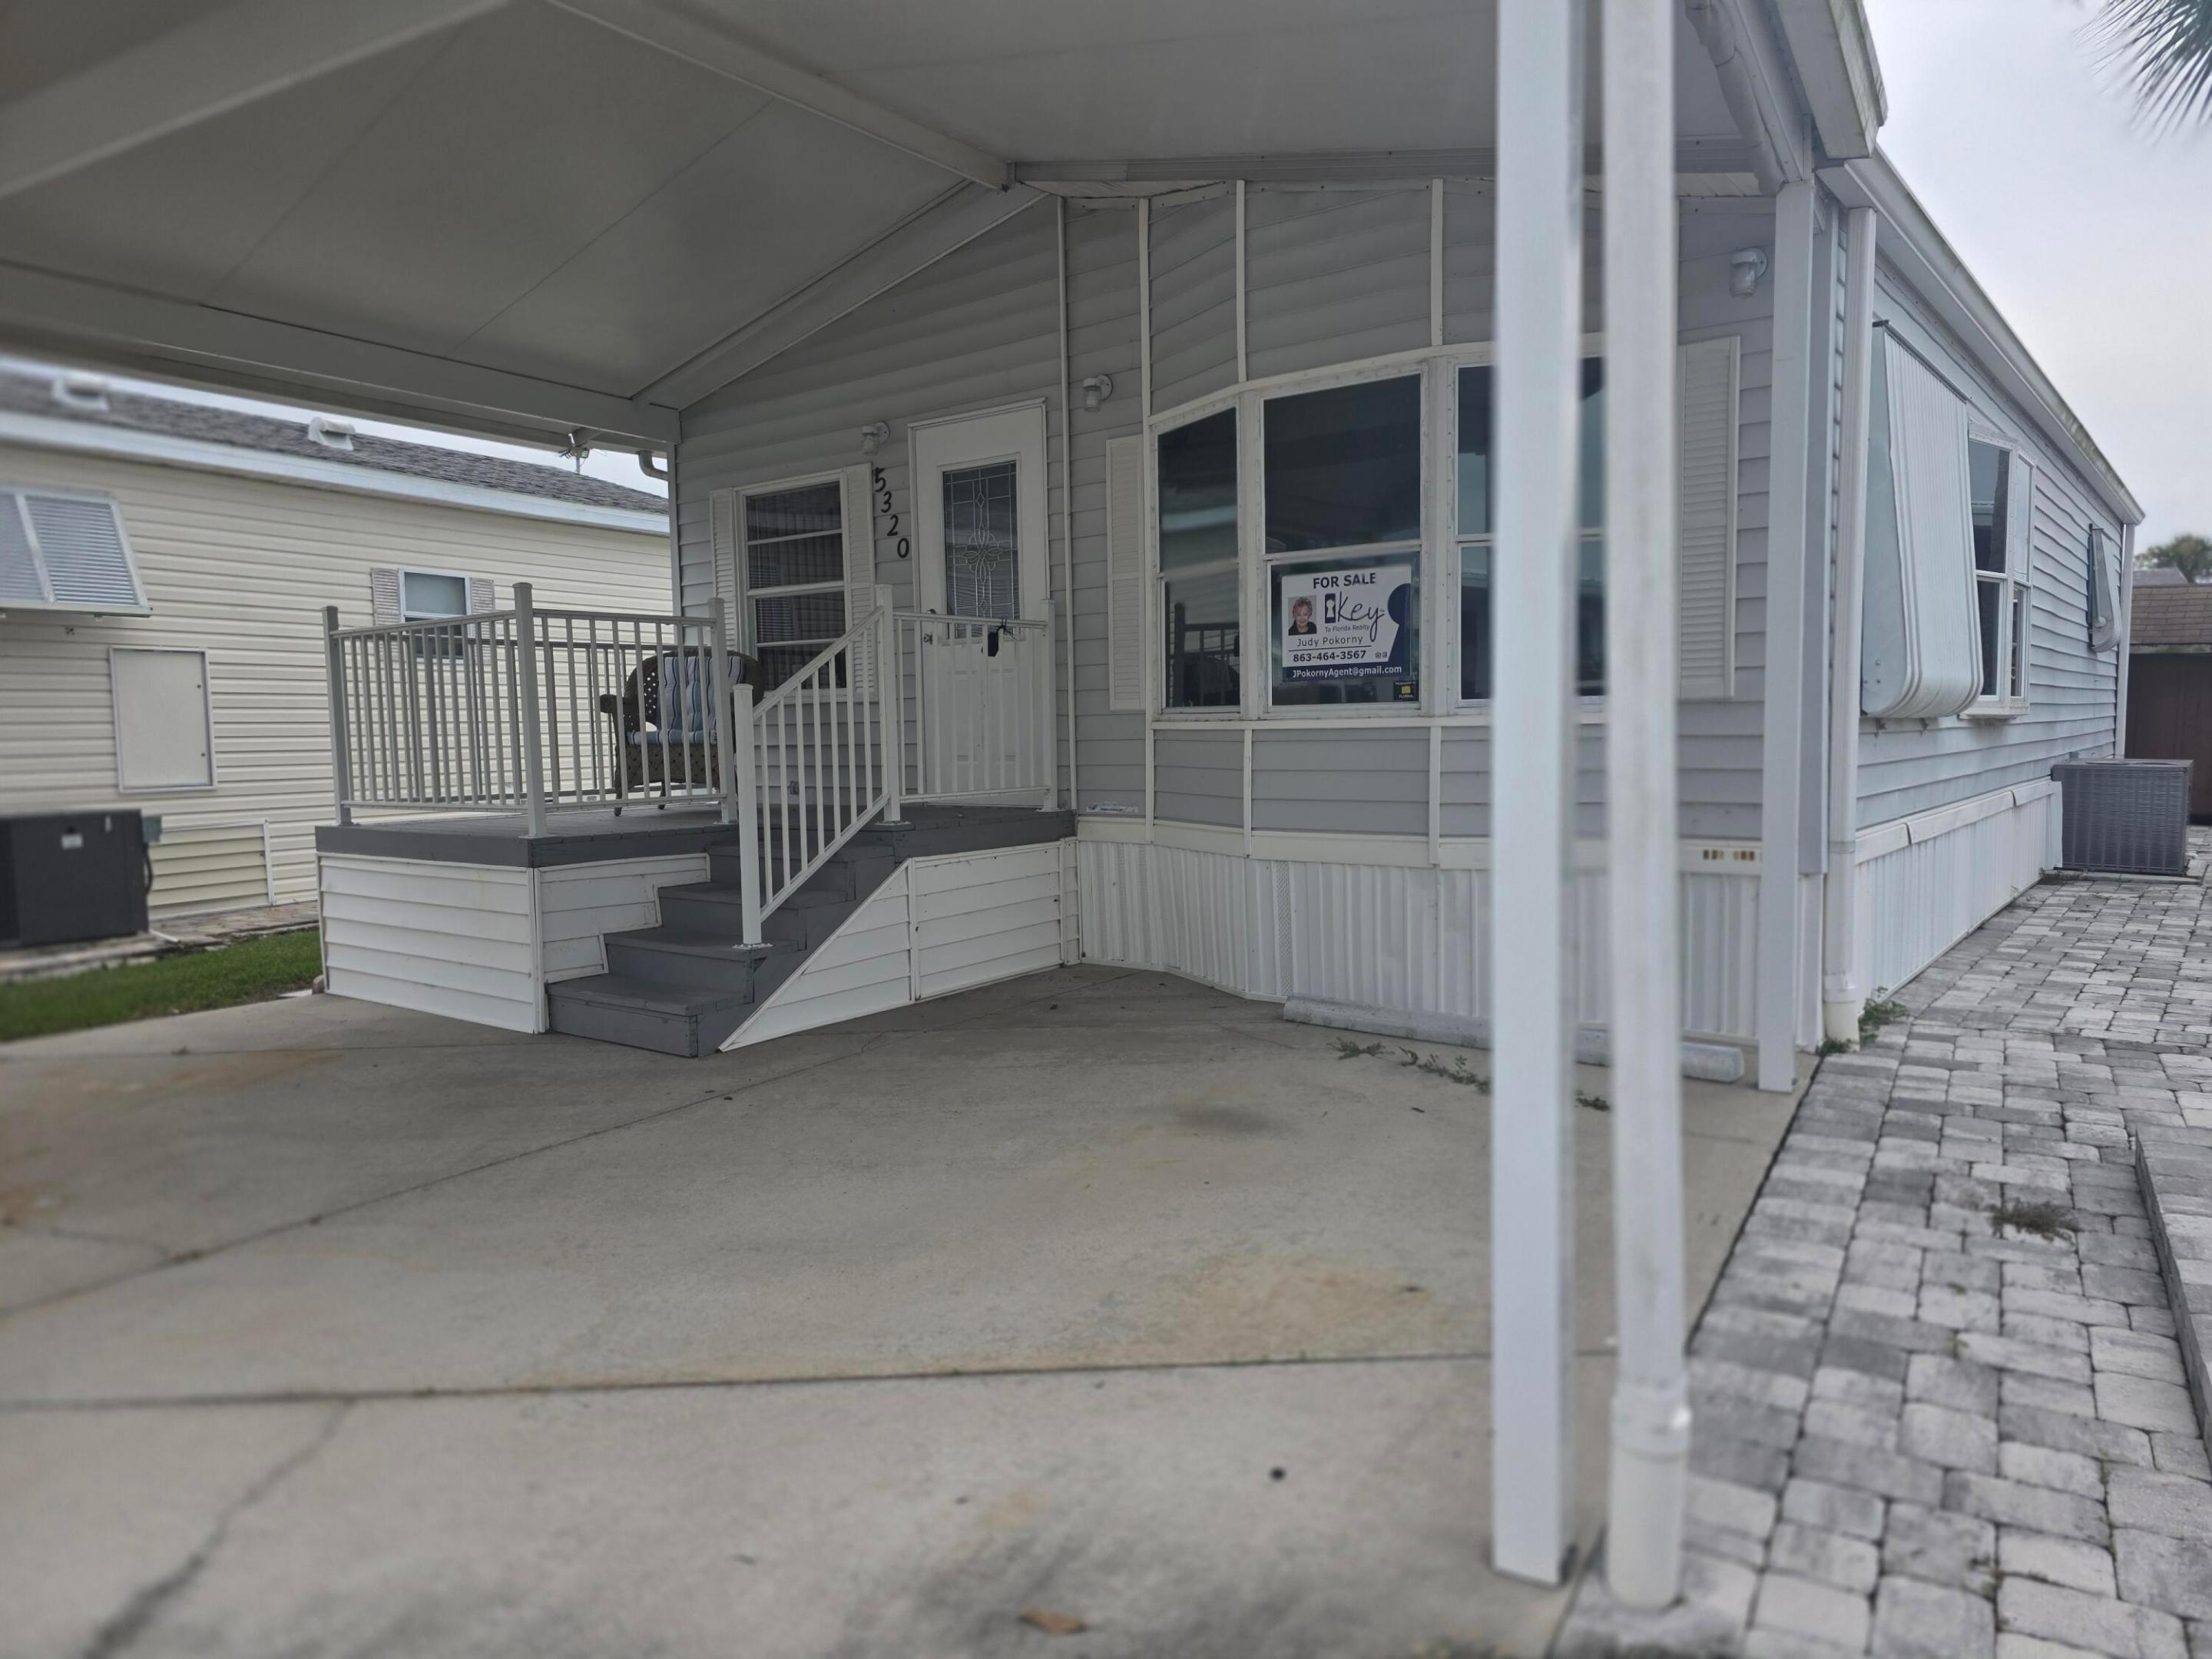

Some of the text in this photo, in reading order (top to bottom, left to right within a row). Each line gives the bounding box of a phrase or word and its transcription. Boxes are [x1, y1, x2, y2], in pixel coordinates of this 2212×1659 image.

[874, 467, 909, 558] 5320
[1313, 572, 1376, 589] FOR SALE
[1337, 591, 1385, 642] Key
[1297, 636, 1363, 647] Judy Pokorny
[1293, 651, 1366, 662] 863-464-3567
[1292, 665, 1402, 678] JPokornyAgent@gmail.com
